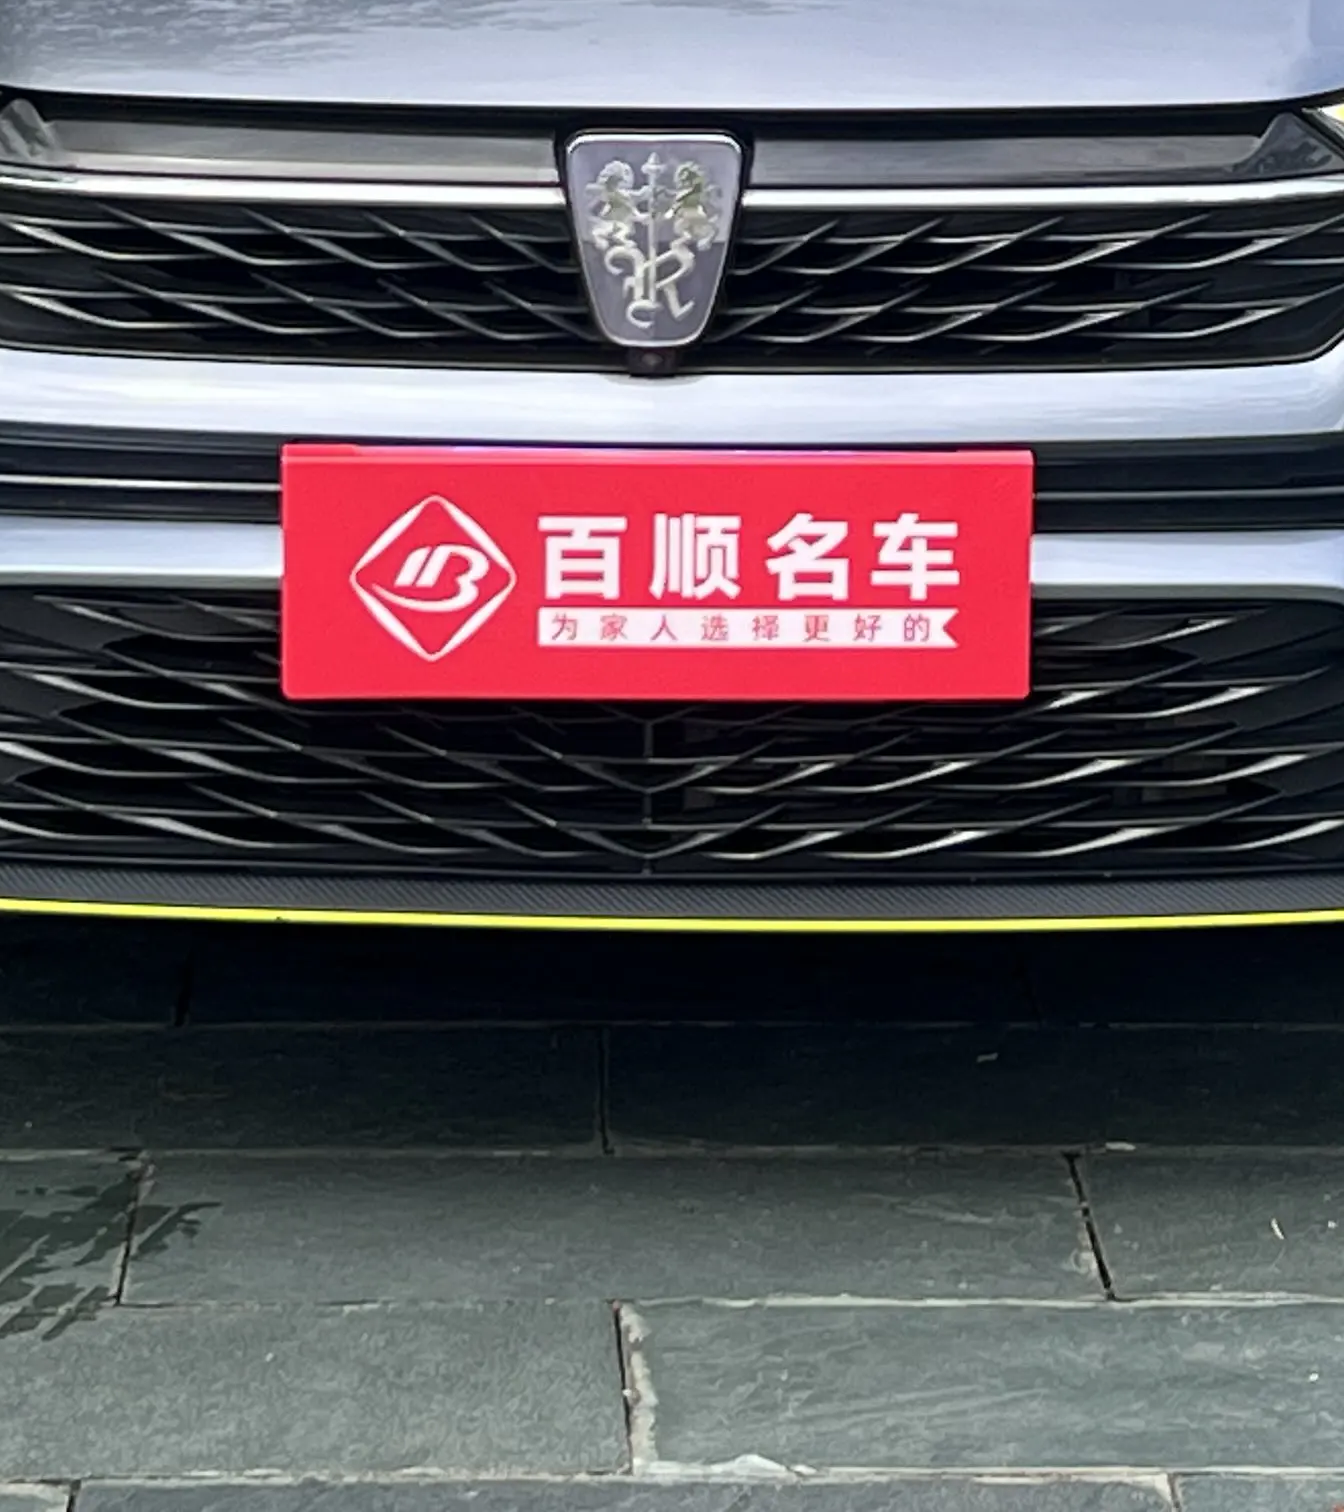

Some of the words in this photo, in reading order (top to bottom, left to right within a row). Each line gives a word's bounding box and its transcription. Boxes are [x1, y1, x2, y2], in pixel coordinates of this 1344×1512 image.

[537, 512, 960, 601] 百顺名车
[551, 613, 930, 642] 为家人选择更好的
